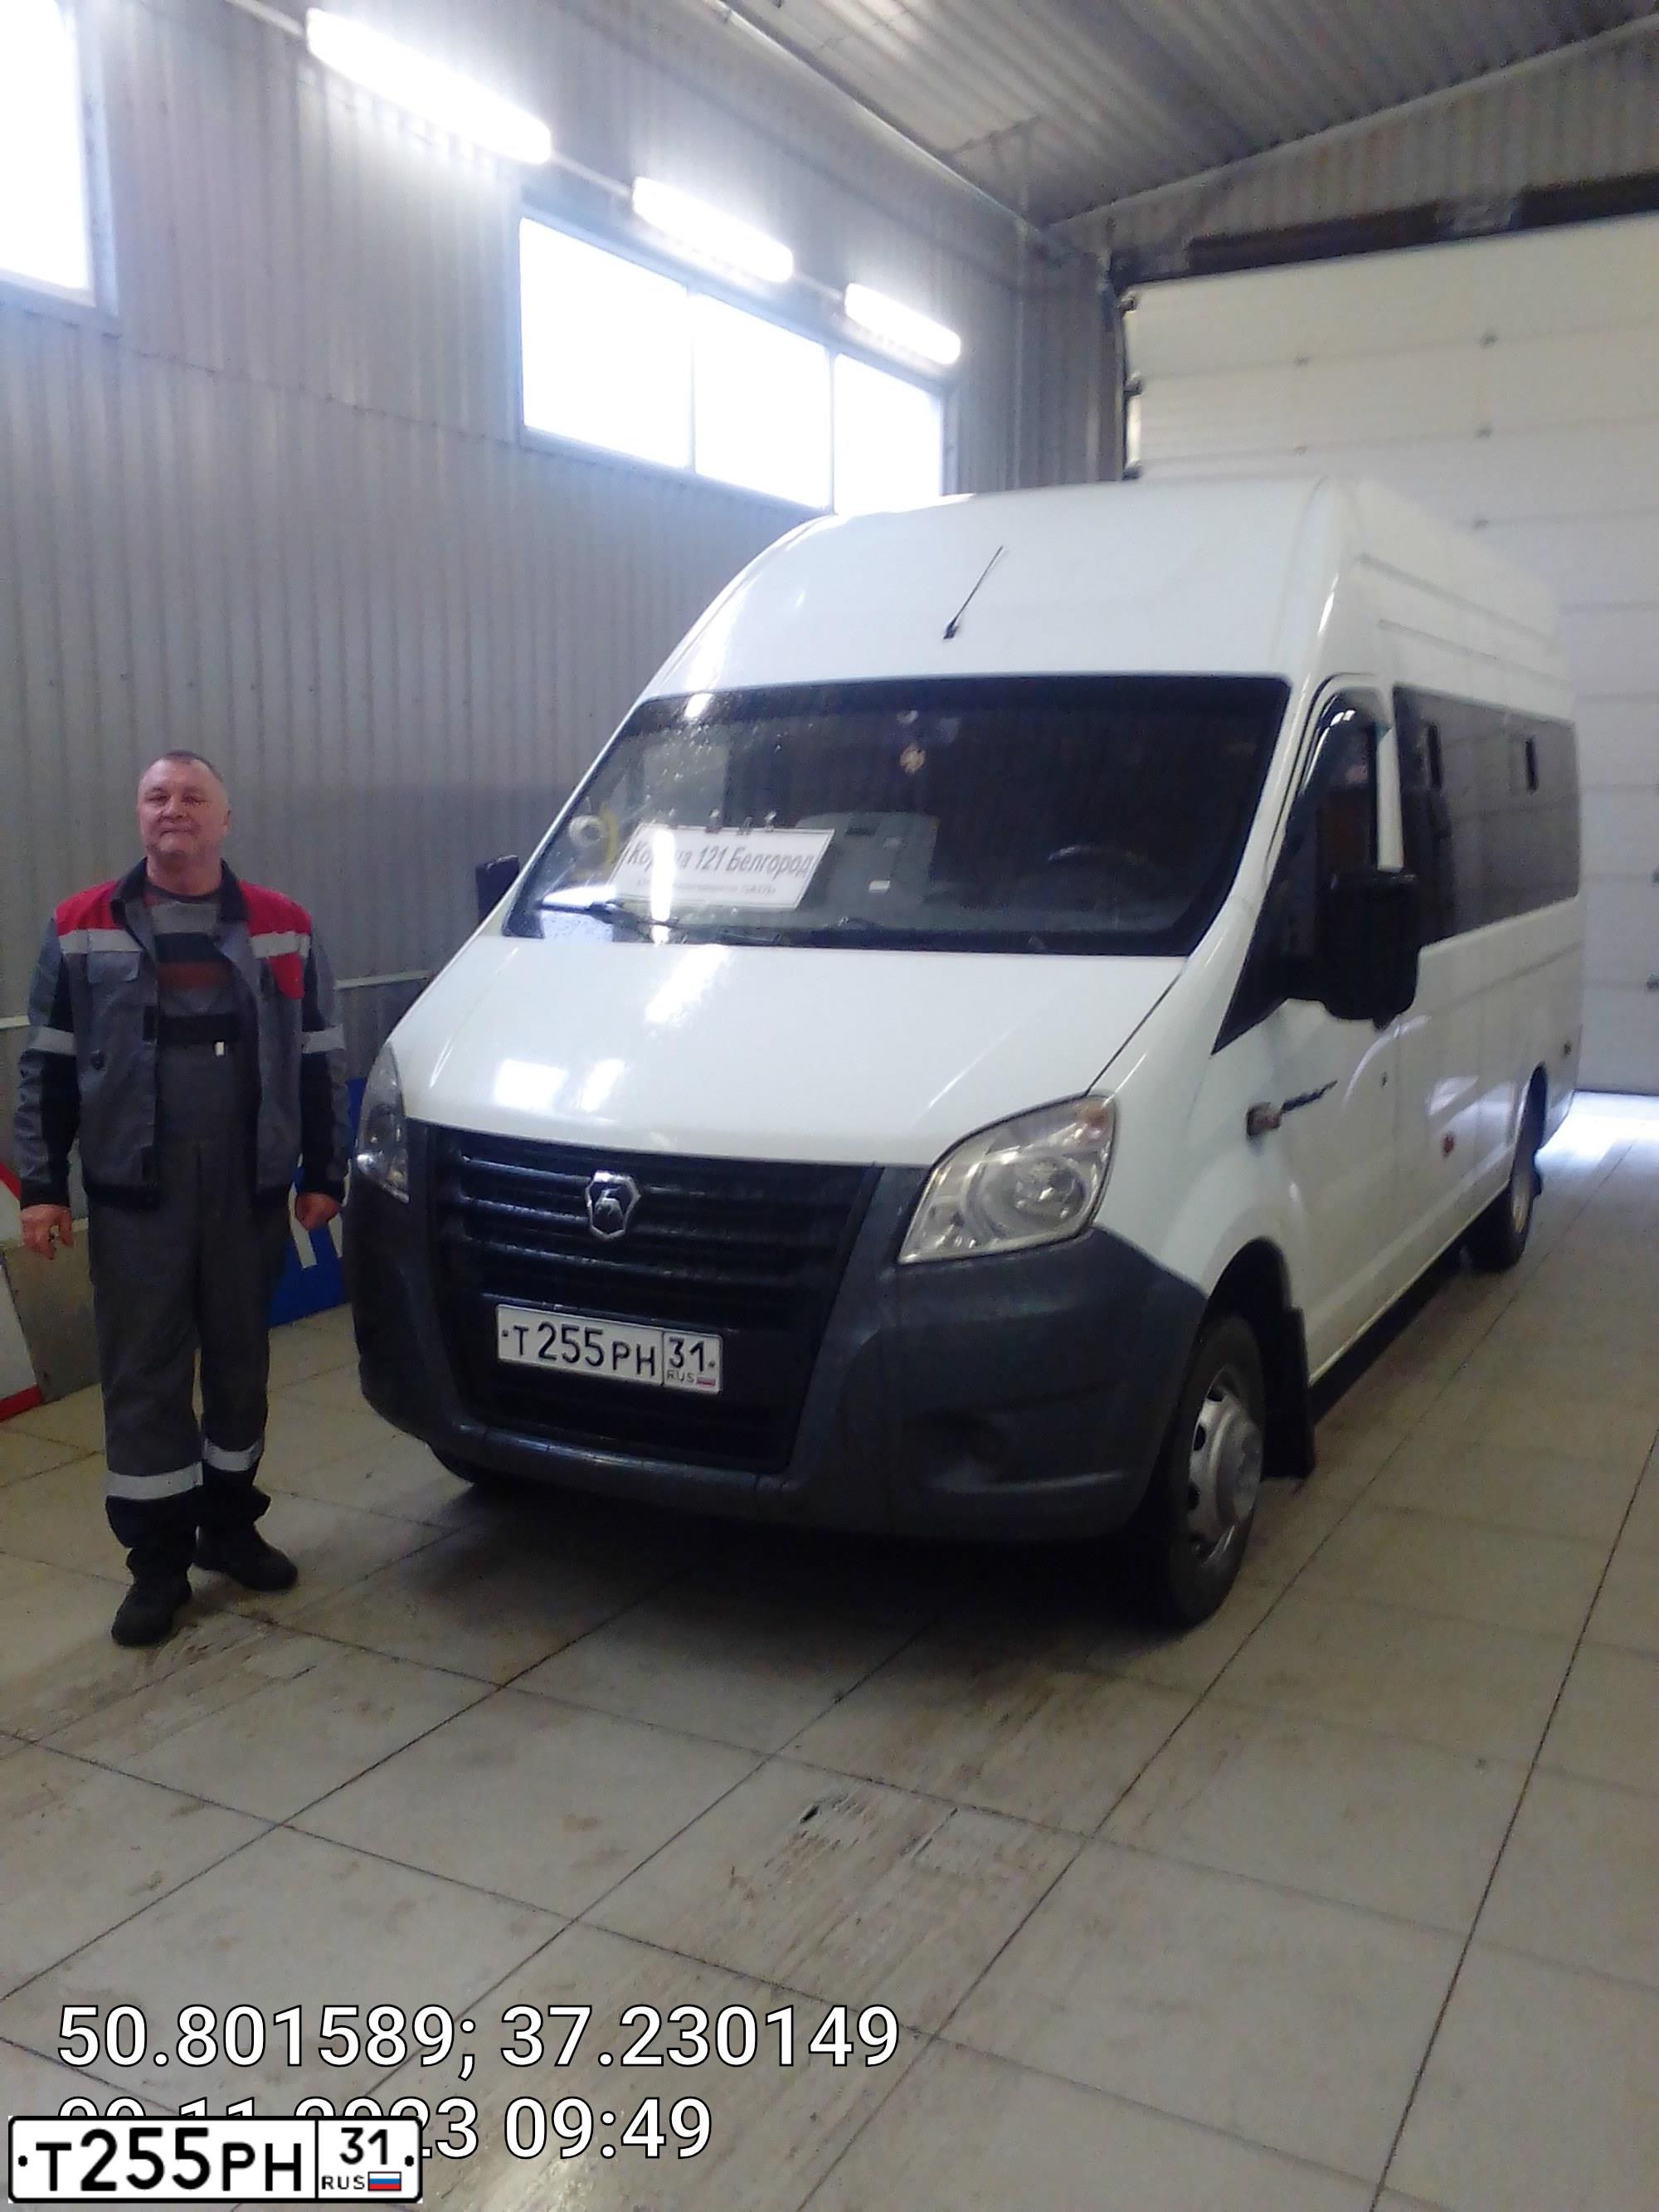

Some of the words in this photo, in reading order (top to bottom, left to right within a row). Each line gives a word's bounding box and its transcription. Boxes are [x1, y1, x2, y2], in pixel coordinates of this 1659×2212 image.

[695, 845, 729, 870] 121
[726, 845, 816, 881] Белгород
[513, 1320, 656, 1377] Т255РН
[668, 1337, 705, 1373] 31
[666, 1372, 695, 1384] RUS
